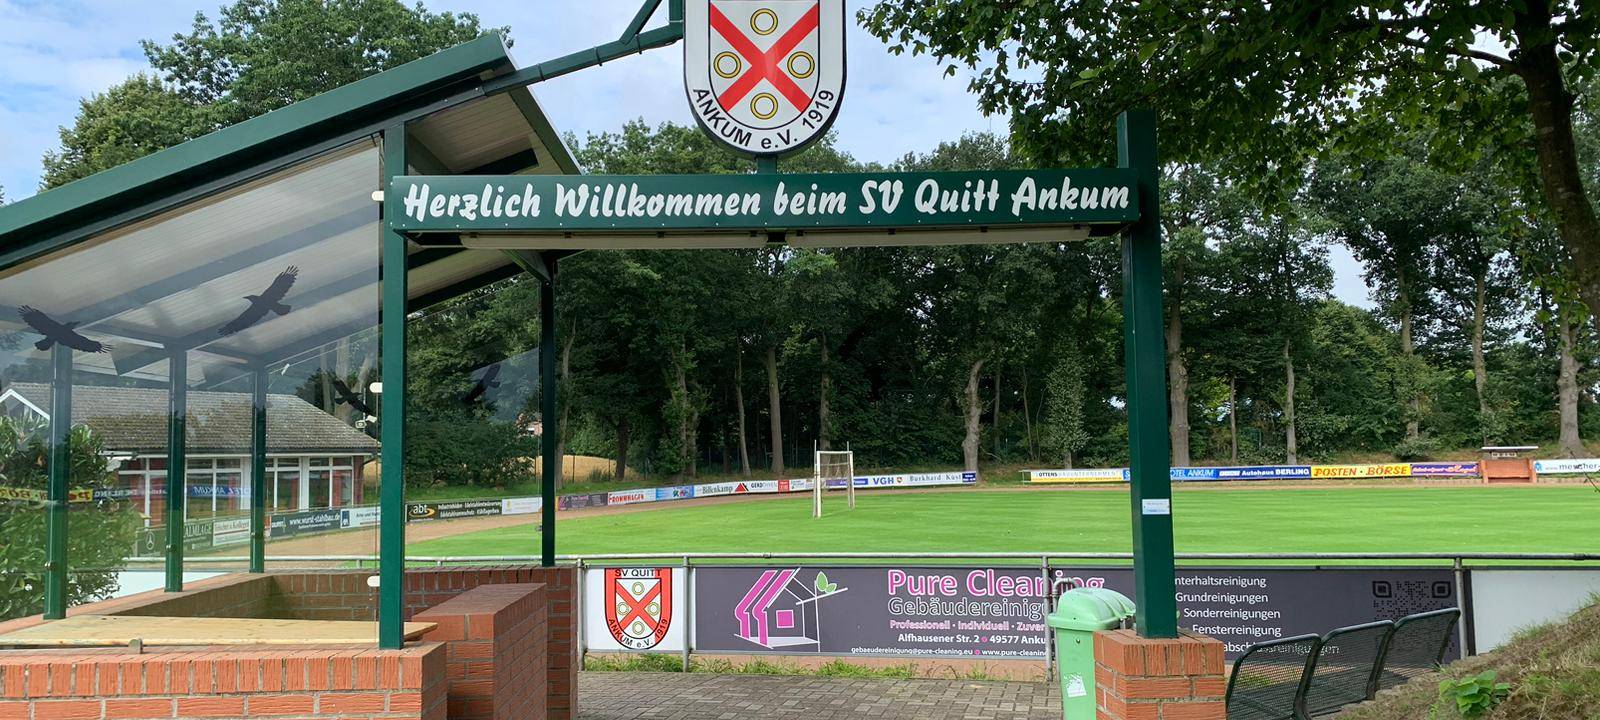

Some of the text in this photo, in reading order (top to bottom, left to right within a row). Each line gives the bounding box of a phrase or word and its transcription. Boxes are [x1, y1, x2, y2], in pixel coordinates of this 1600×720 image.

[693, 88, 834, 149] ANKUM e.V. 1919
[404, 176, 1130, 221] Herzlich Willkommen beim SV Quitt Ankum
[1188, 468, 1214, 477] ANKUM
[1314, 467, 1357, 477] POSTEN
[1366, 465, 1408, 476] BÖRSE
[872, 477, 894, 485] VGH
[412, 504, 428, 514] abt
[887, 569, 957, 596] Pure
[1174, 576, 1267, 588] nterhaltsreinigung
[1175, 592, 1268, 604] Grundreinigungen
[888, 597, 1047, 621] Gebäudereinig
[1184, 608, 1281, 620] Sonderreinigungen
[608, 618, 633, 646] ANKUM
[655, 618, 668, 639] 1919
[890, 620, 1046, 632] Professionell Individuell Zuver
[1192, 625, 1282, 638] Fensterreinigung
[898, 634, 1046, 644] Alfhausener Str. 2 49577 Anku
[851, 646, 973, 656] gebaeudereinigung@pure-cleaning.eu
